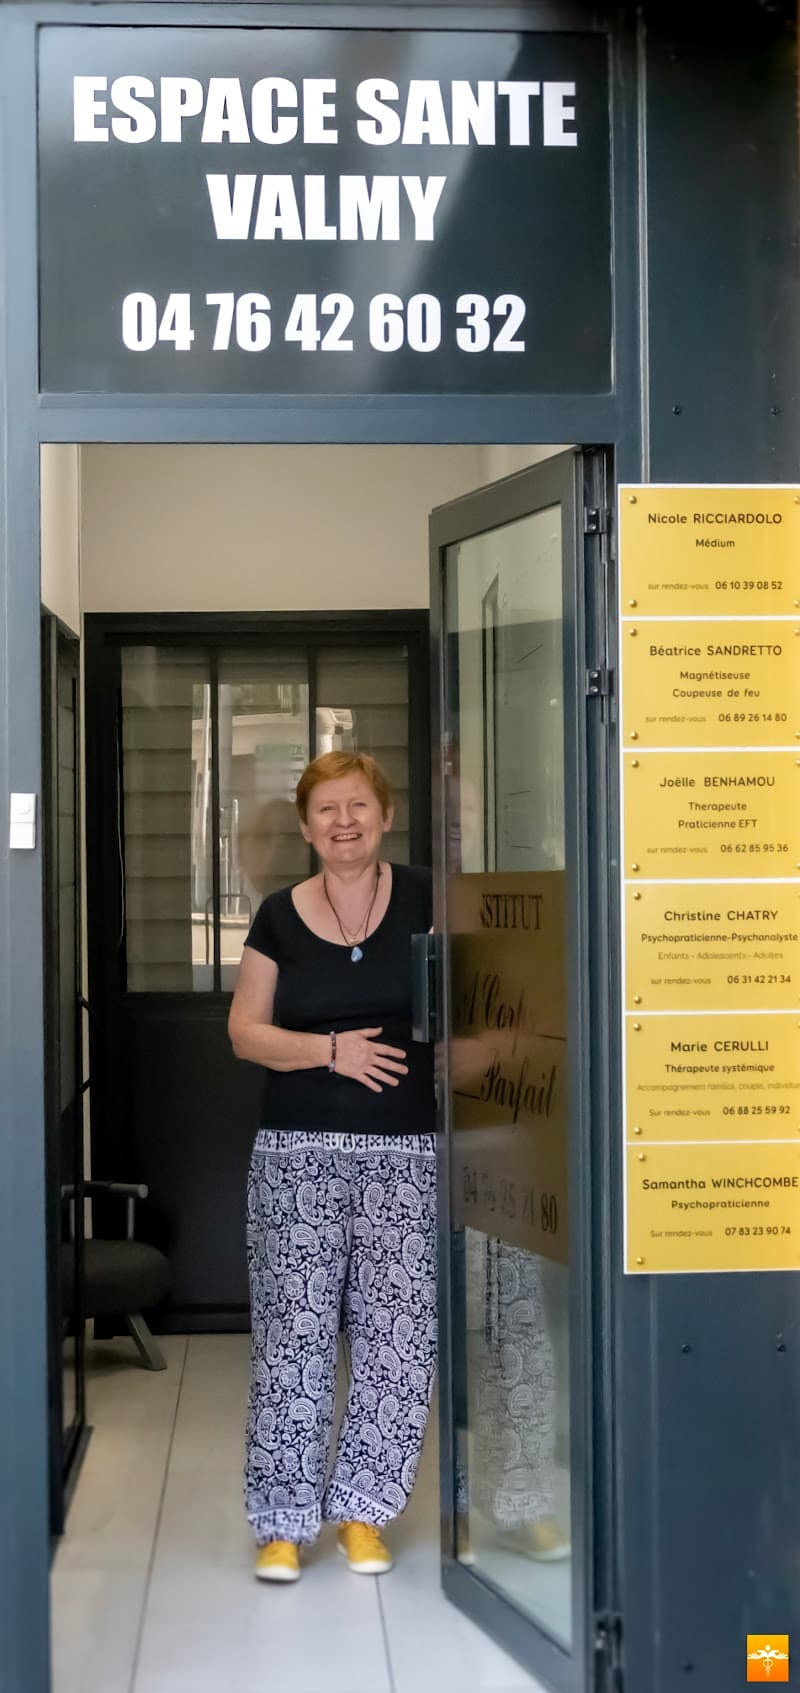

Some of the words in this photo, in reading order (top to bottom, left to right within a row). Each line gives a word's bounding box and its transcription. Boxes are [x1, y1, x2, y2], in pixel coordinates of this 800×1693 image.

[72, 76, 338, 144] ESPACE
[356, 78, 577, 146] SANTE
[205, 173, 447, 242] VALMY
[121, 292, 194, 353] 04
[205, 292, 273, 353] 76
[284, 292, 354, 353] 42
[369, 292, 443, 353] 60
[456, 292, 527, 353] 32
[648, 514, 687, 524] Nicole
[694, 514, 782, 524] RICCIARDOLO
[696, 539, 735, 547] Médium
[662, 582, 708, 590] rendez-vous
[650, 646, 701, 656] Béatrice
[707, 646, 782, 656] SANDRETTO
[680, 671, 750, 681] Magnétiseuse
[673, 689, 722, 699] Coupeuse
[728, 689, 740, 697] de
[744, 689, 760, 697] feu
[719, 714, 730, 722] 06
[734, 714, 745, 722] 89
[748, 714, 759, 722] 26
[763, 714, 772, 722] 14
[775, 714, 786, 722] 80
[660, 777, 695, 788] Joëlle
[704, 777, 774, 787] BENHAMOU
[688, 802, 747, 811] Therapeute
[678, 820, 736, 829] Praticienne
[739, 820, 757, 828] EFT
[661, 846, 707, 854] rendez-vous
[721, 845, 732, 853] 06
[735, 845, 746, 853] 62
[749, 845, 760, 853] 85
[763, 845, 774, 853] 95
[664, 911, 720, 921] Christine
[728, 911, 778, 920] CHATRY
[642, 933, 798, 943] Psychopraticienne-Psychanalyste
[658, 952, 689, 960] Enfants
[664, 977, 711, 985] rendez-vous
[728, 976, 740, 984] 06
[743, 976, 751, 984] 31
[754, 976, 765, 984] 42
[768, 976, 777, 984] 21
[671, 1042, 708, 1052] Marie
[714, 1041, 769, 1051] CERULLI
[666, 1064, 720, 1073] Thérapeute
[722, 1063, 774, 1073] systémique
[723, 1107, 735, 1115] 06
[738, 1107, 749, 1115] 88
[752, 1107, 763, 1115] 25
[765, 1106, 777, 1115] 59
[780, 1106, 790, 1114] 92
[643, 1179, 706, 1190] Samantha
[712, 1178, 798, 1188] WINCHCOMBE
[672, 1200, 770, 1210] Psychopraticienne
[540, 1193, 558, 1234] 80
[725, 1228, 736, 1236] 07
[739, 1228, 750, 1236] 83
[753, 1227, 764, 1236] 23
[766, 1227, 778, 1236] 90
[781, 1227, 791, 1235] 74
